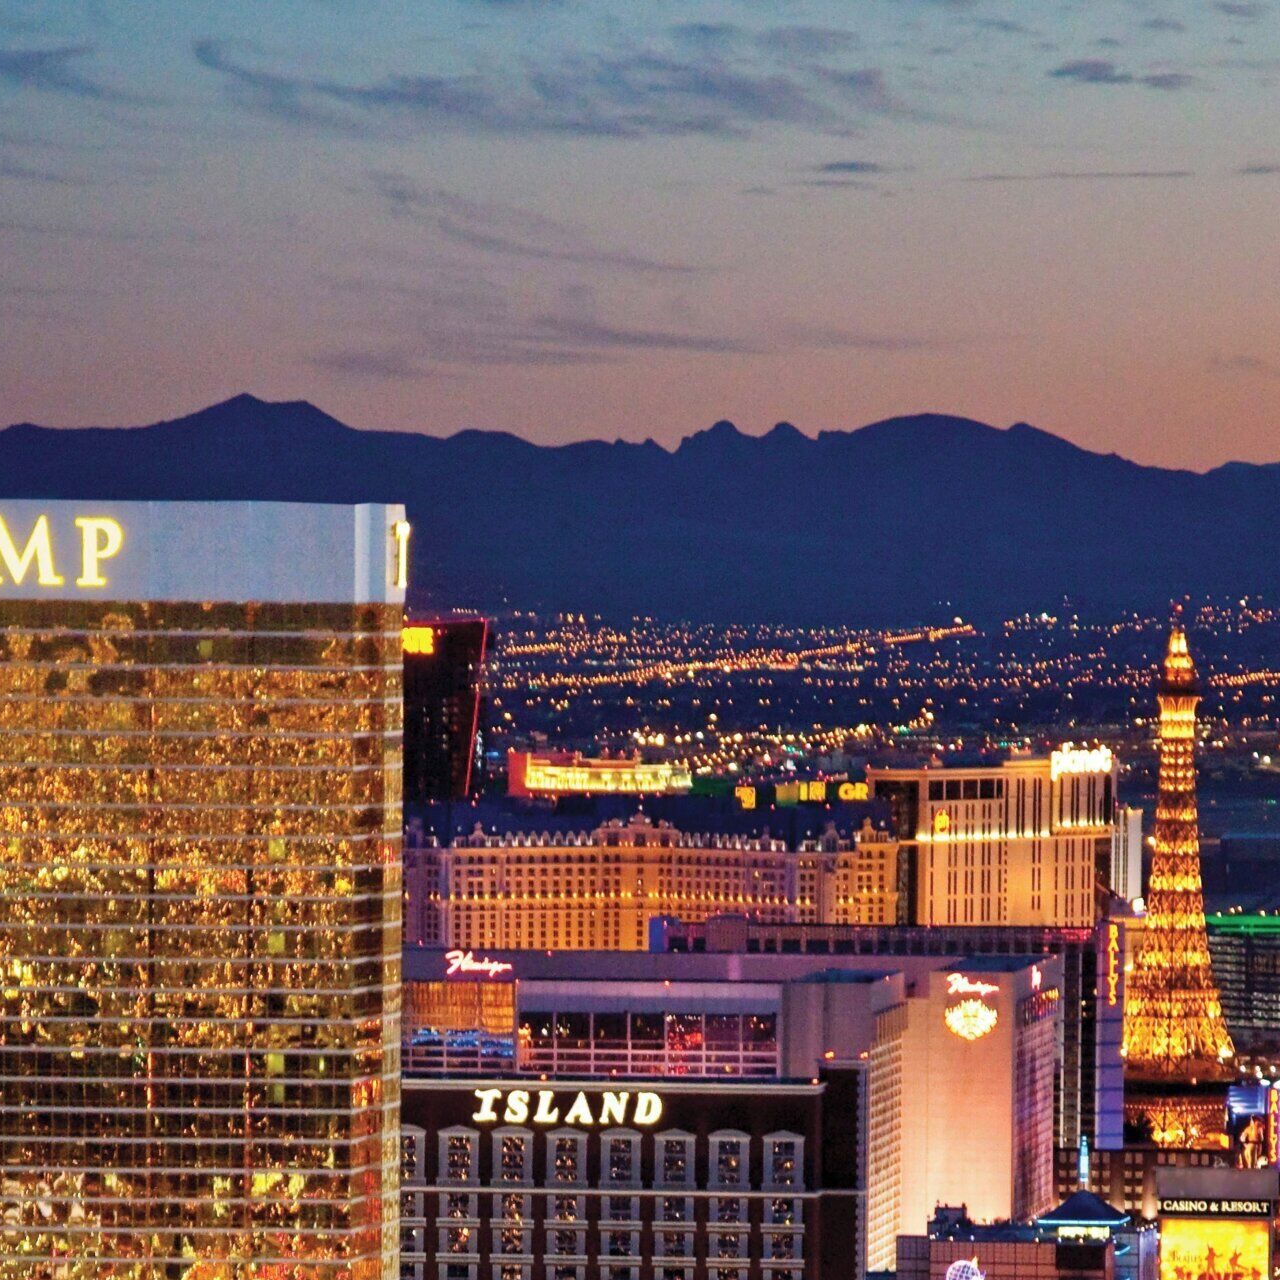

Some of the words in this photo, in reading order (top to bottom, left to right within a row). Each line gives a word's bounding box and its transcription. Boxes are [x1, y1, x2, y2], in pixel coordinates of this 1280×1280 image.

[472, 1088, 663, 1125] ISLAND
[1163, 1200, 1208, 1212] CASINO
[1209, 1202, 1219, 1212] &
[1221, 1201, 1269, 1214] RESORT
